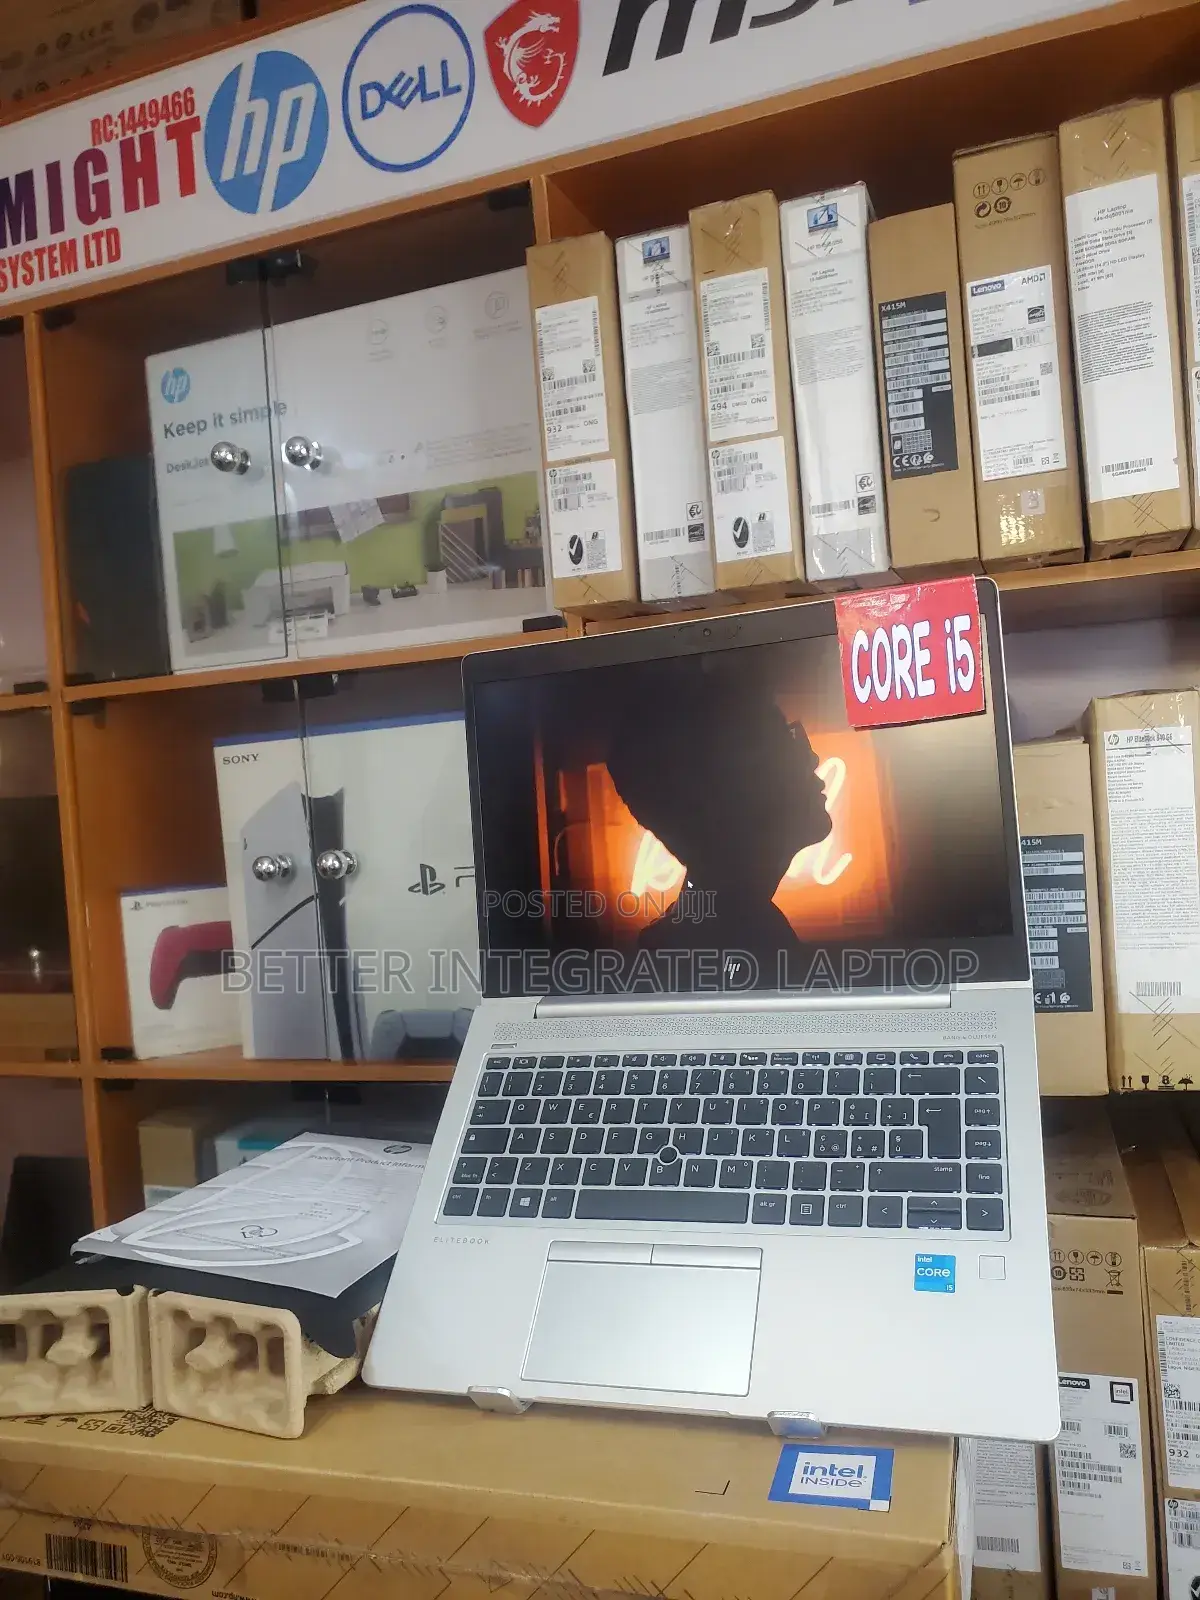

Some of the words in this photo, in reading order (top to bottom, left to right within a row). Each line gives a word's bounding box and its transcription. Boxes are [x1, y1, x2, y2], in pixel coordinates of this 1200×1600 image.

[360, 59, 463, 121] DELL
[90, 87, 196, 146] RC:1449466
[216, 51, 318, 214] hp
[0, 116, 201, 249] MIGHT
[1107, 204, 1127, 213] Laptop
[0, 238, 79, 293] SYSTEM
[84, 227, 121, 270] LTD
[1021, 275, 1039, 285] AMD
[973, 282, 1002, 294] Lenovo
[881, 302, 906, 312] X415M
[711, 402, 728, 411] 494
[750, 396, 767, 404] ONG
[163, 419, 207, 439] Keep
[213, 413, 224, 428] it
[230, 401, 287, 424] simple
[547, 425, 562, 433] 932
[852, 620, 935, 703] CORE
[944, 614, 975, 694] i5
[222, 754, 259, 765] SONY
[749, 1134, 756, 1142] K
[355, 1158, 392, 1166] Product
[433, 1236, 490, 1244] ELITEBOOK
[1169, 1449, 1189, 1458] 932
[802, 1462, 864, 1478] intel
